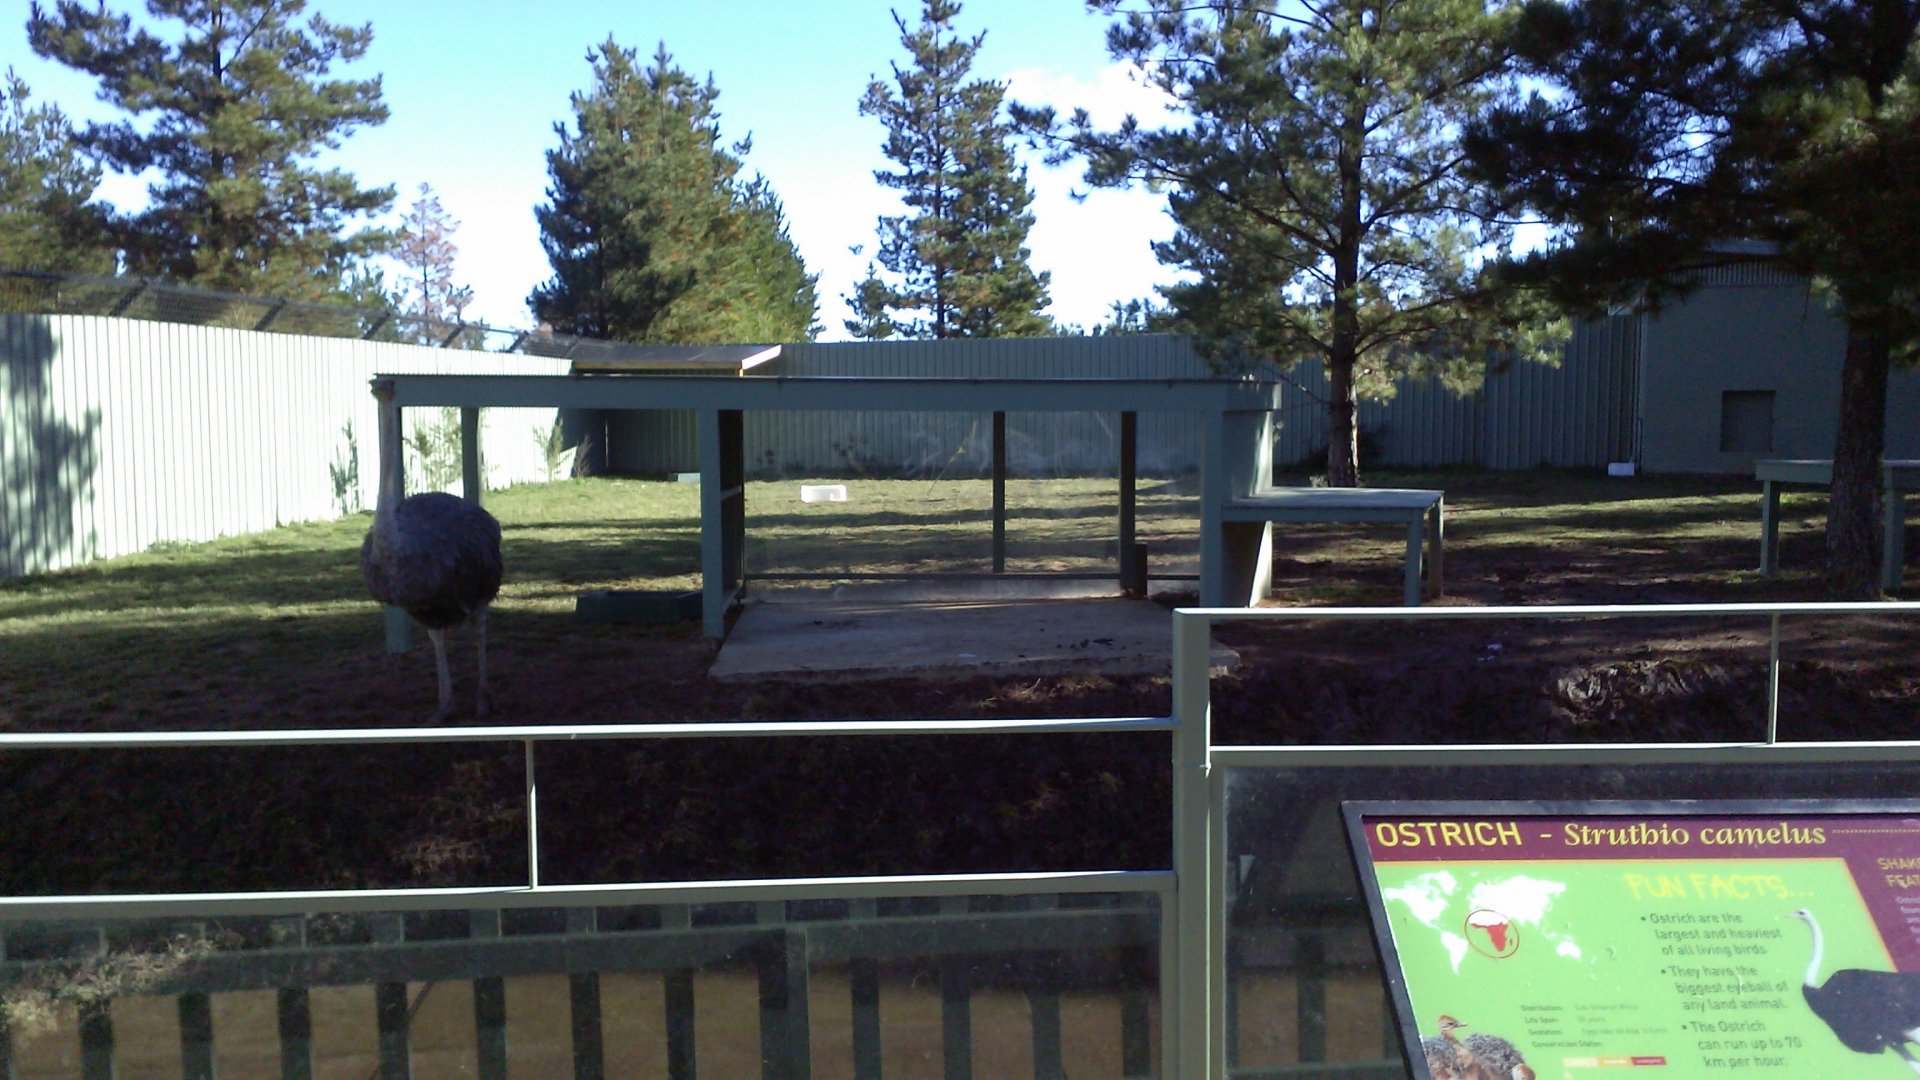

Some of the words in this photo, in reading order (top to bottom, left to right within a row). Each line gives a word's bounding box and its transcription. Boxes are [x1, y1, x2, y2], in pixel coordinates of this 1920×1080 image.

[1376, 822, 1522, 847] OSTRICH
[1700, 822, 1826, 845] camelus
[1625, 873, 1686, 900] FUN
[1650, 913, 1696, 924] Ostrich
[1699, 915, 1720, 923] are
[1721, 913, 1743, 923] the
[1655, 929, 1700, 942] largest
[1703, 929, 1727, 939] and
[1729, 929, 1782, 939] heaviest
[1662, 945, 1673, 955] of
[1677, 945, 1694, 955] all
[1696, 944, 1732, 957] living
[1668, 965, 1700, 979] They
[1703, 966, 1735, 976] have
[1735, 965, 1758, 976] the
[1675, 982, 1723, 996] biggest
[1727, 982, 1773, 995] eyeball
[1775, 981, 1788, 992] of
[1683, 1000, 1705, 1012] any
[1707, 999, 1737, 1010] land
[1690, 1021, 1715, 1032] The
[1718, 1021, 1766, 1032] Ostrich
[1698, 1040, 1720, 1050] can
[1724, 1040, 1747, 1049] run
[1751, 1040, 1767, 1050] up
[1769, 1038, 1783, 1048] to
[1785, 1036, 1802, 1048] 70
[1703, 1056, 1726, 1067] km
[1729, 1057, 1750, 1069] per
